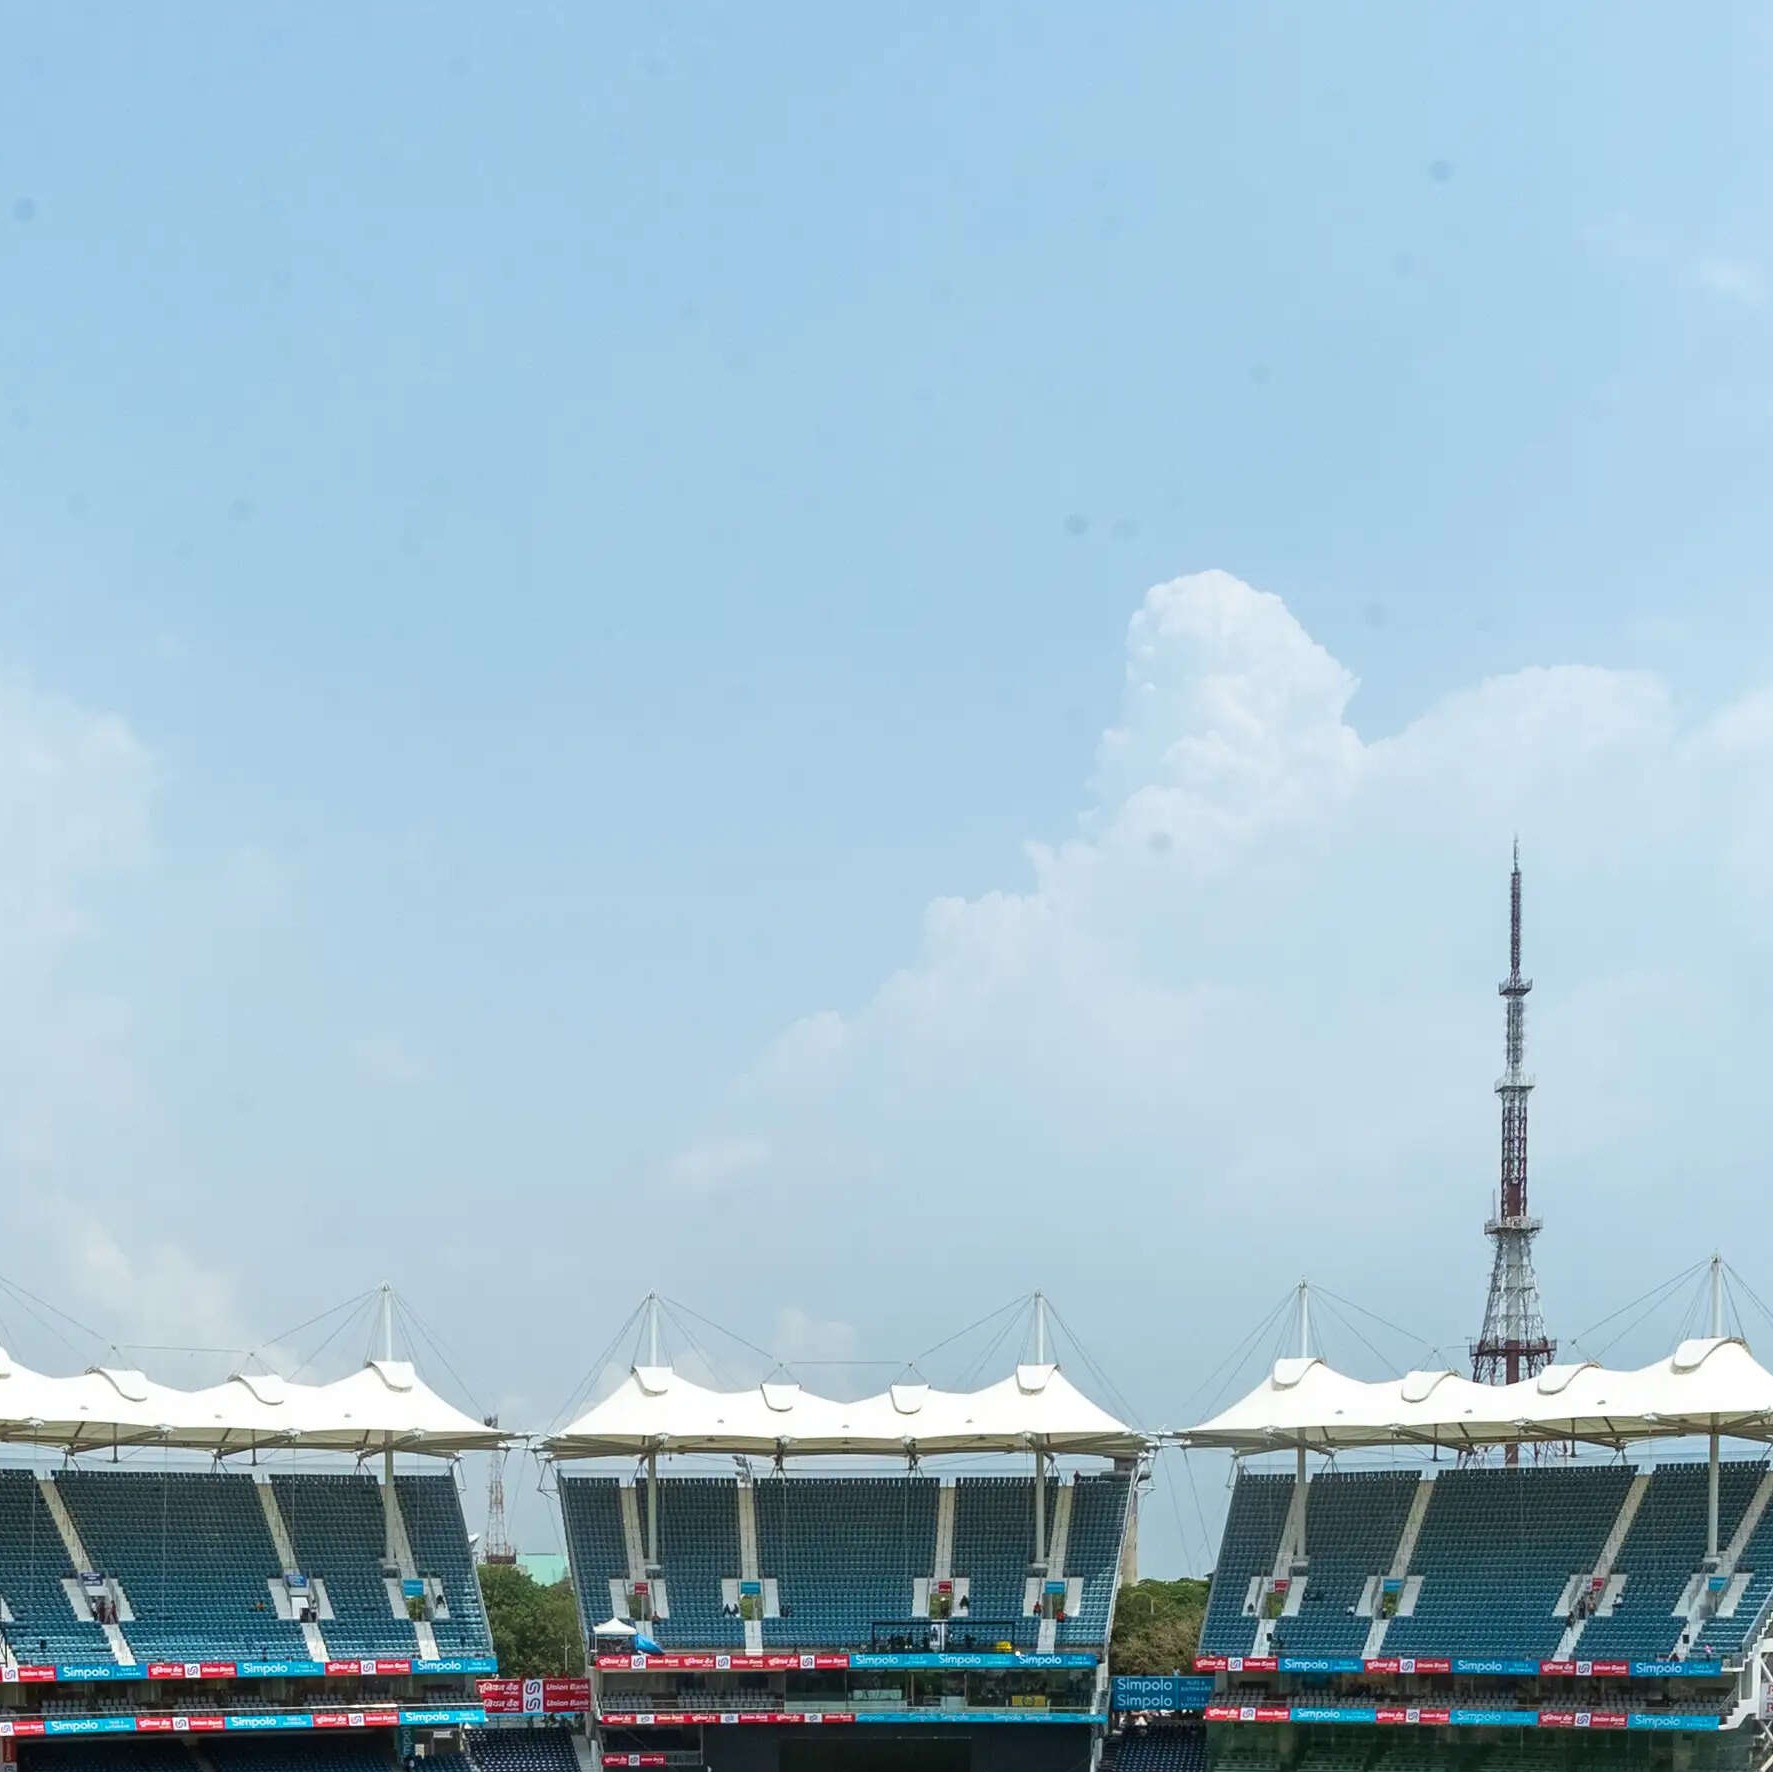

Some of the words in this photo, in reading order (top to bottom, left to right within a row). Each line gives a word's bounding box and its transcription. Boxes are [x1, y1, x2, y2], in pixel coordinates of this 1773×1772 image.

[417, 1659, 462, 1672] Simpolo
[854, 1654, 899, 1667] Simpolo
[1018, 1654, 1063, 1667] Simpolo
[1284, 1658, 1329, 1672] Simpolo
[1457, 1659, 1502, 1673] Simpolo
[63, 1666, 110, 1680] Simpolo
[243, 1662, 289, 1676] Simpolo
[1636, 1661, 1683, 1676] Simpolo
[1117, 1679, 1173, 1693] Simpolo
[1117, 1694, 1173, 1709] Simpolo
